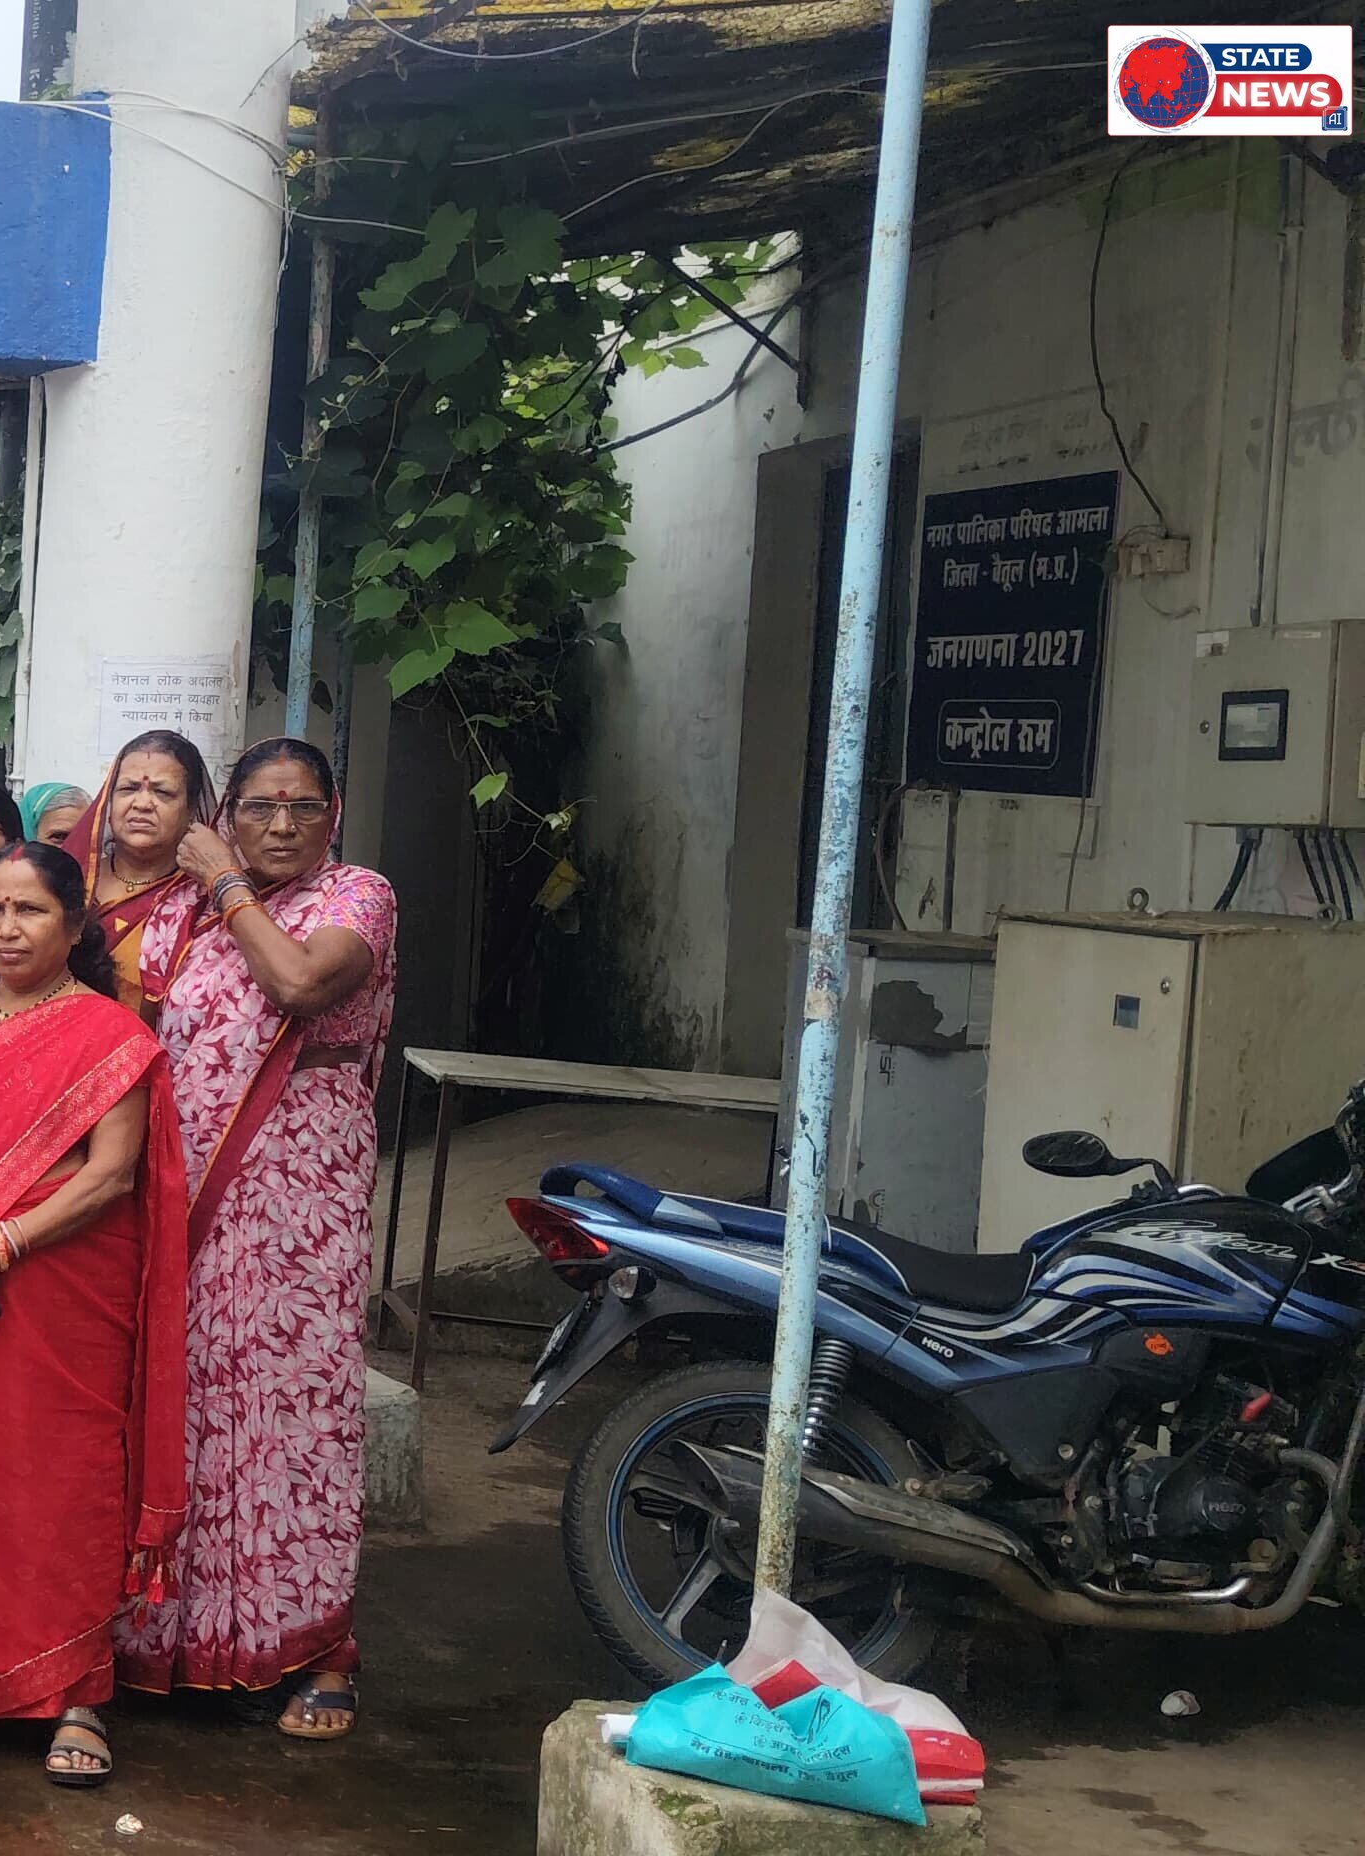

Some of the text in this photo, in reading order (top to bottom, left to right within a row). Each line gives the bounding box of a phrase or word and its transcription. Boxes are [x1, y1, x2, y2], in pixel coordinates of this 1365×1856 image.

[926, 523, 953, 549] नगर
[957, 514, 1007, 545] पालिका
[1057, 506, 1110, 536] आमला
[943, 558, 980, 589] जिला
[926, 629, 1085, 669] जनगणना 2027
[111, 672, 150, 687] नेशनल
[157, 672, 182, 687] लोक
[113, 692, 128, 704] का
[134, 690, 181, 704] आयोजन
[174, 709, 182, 722] में
[188, 710, 213, 722] किया
[945, 706, 1054, 759] कन्ट्रोल रूम
